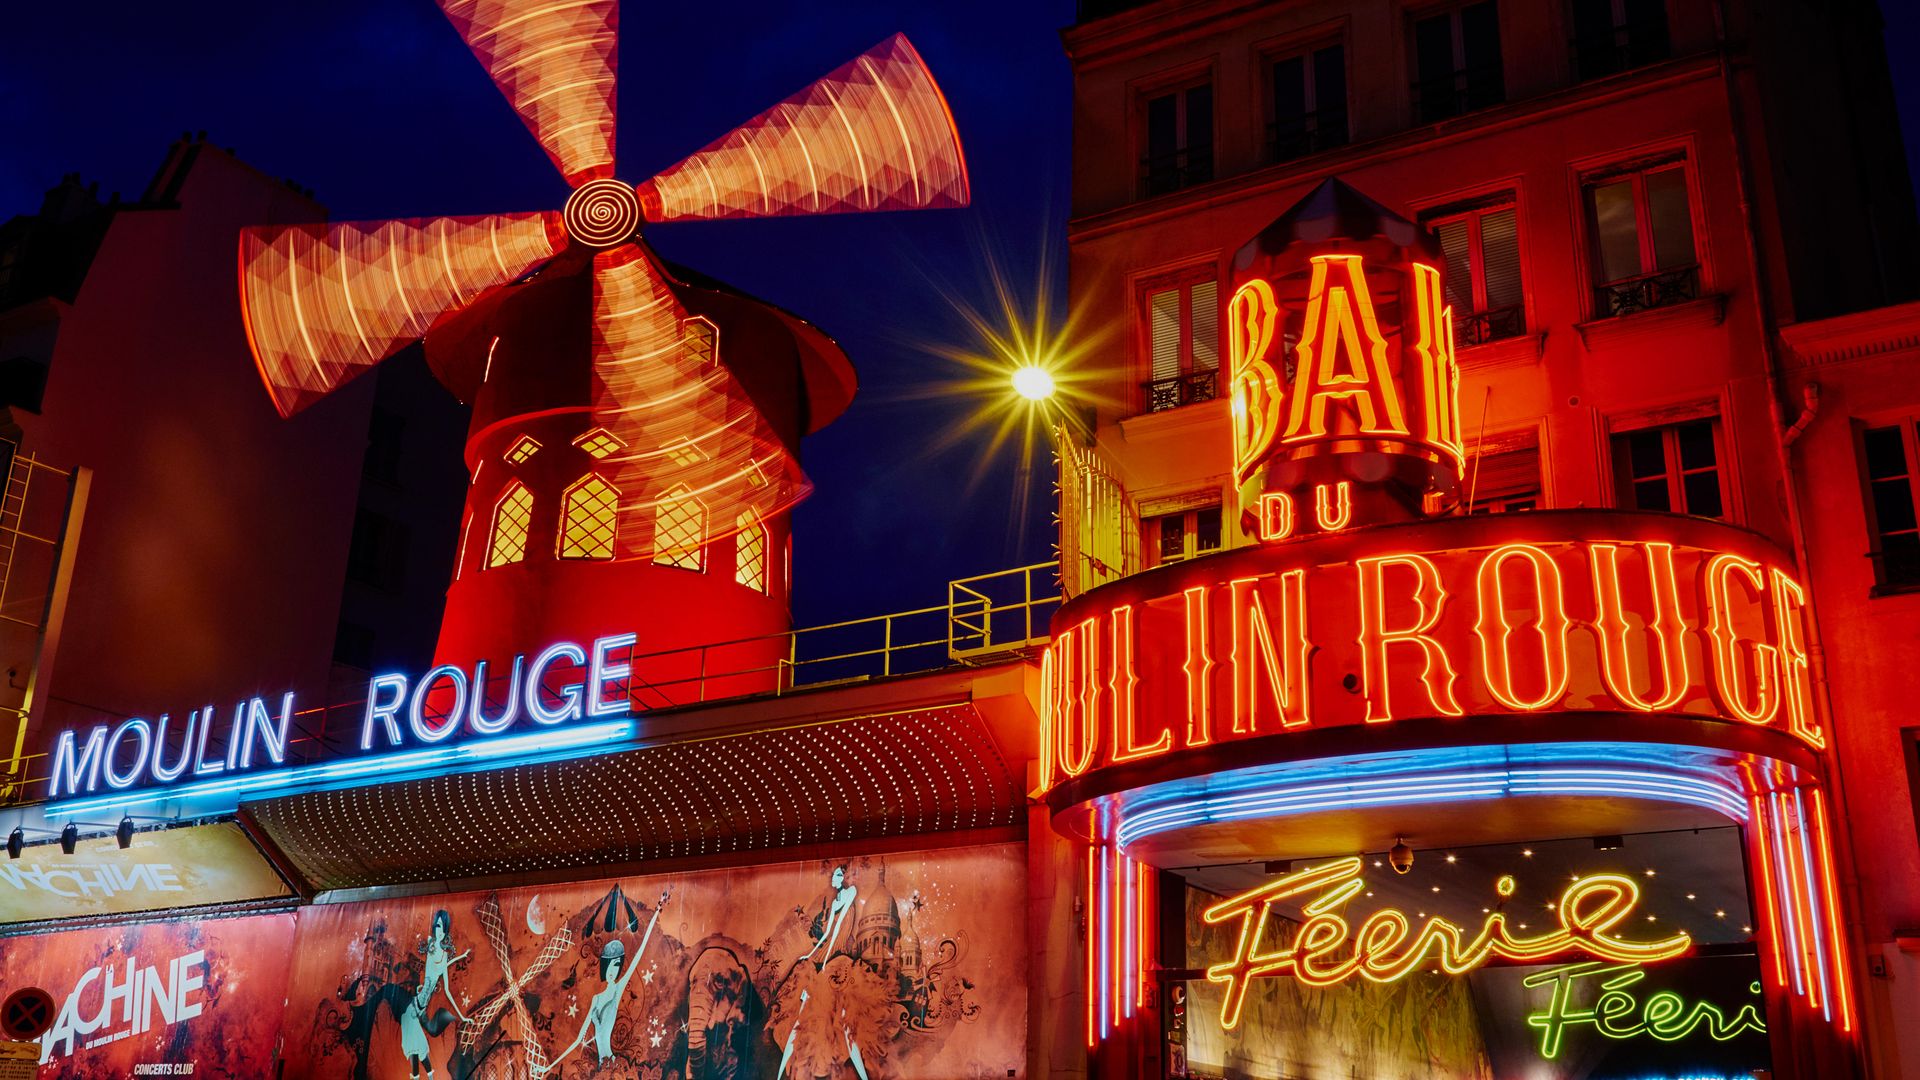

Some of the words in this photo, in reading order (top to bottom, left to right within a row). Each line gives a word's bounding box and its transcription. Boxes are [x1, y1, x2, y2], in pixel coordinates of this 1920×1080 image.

[1259, 481, 1350, 541] DU
[48, 690, 296, 798] MOULIN
[360, 632, 638, 751] ROUGE
[1040, 569, 1310, 793] OULIN
[1355, 541, 1826, 751] ROUGE
[1204, 856, 1692, 1030] Féerie
[38, 950, 205, 1066] ACHINE
[1523, 961, 1768, 1059] Féeri
[133, 1063, 172, 1076] CONCERTS
[174, 1063, 194, 1075] CLUB
